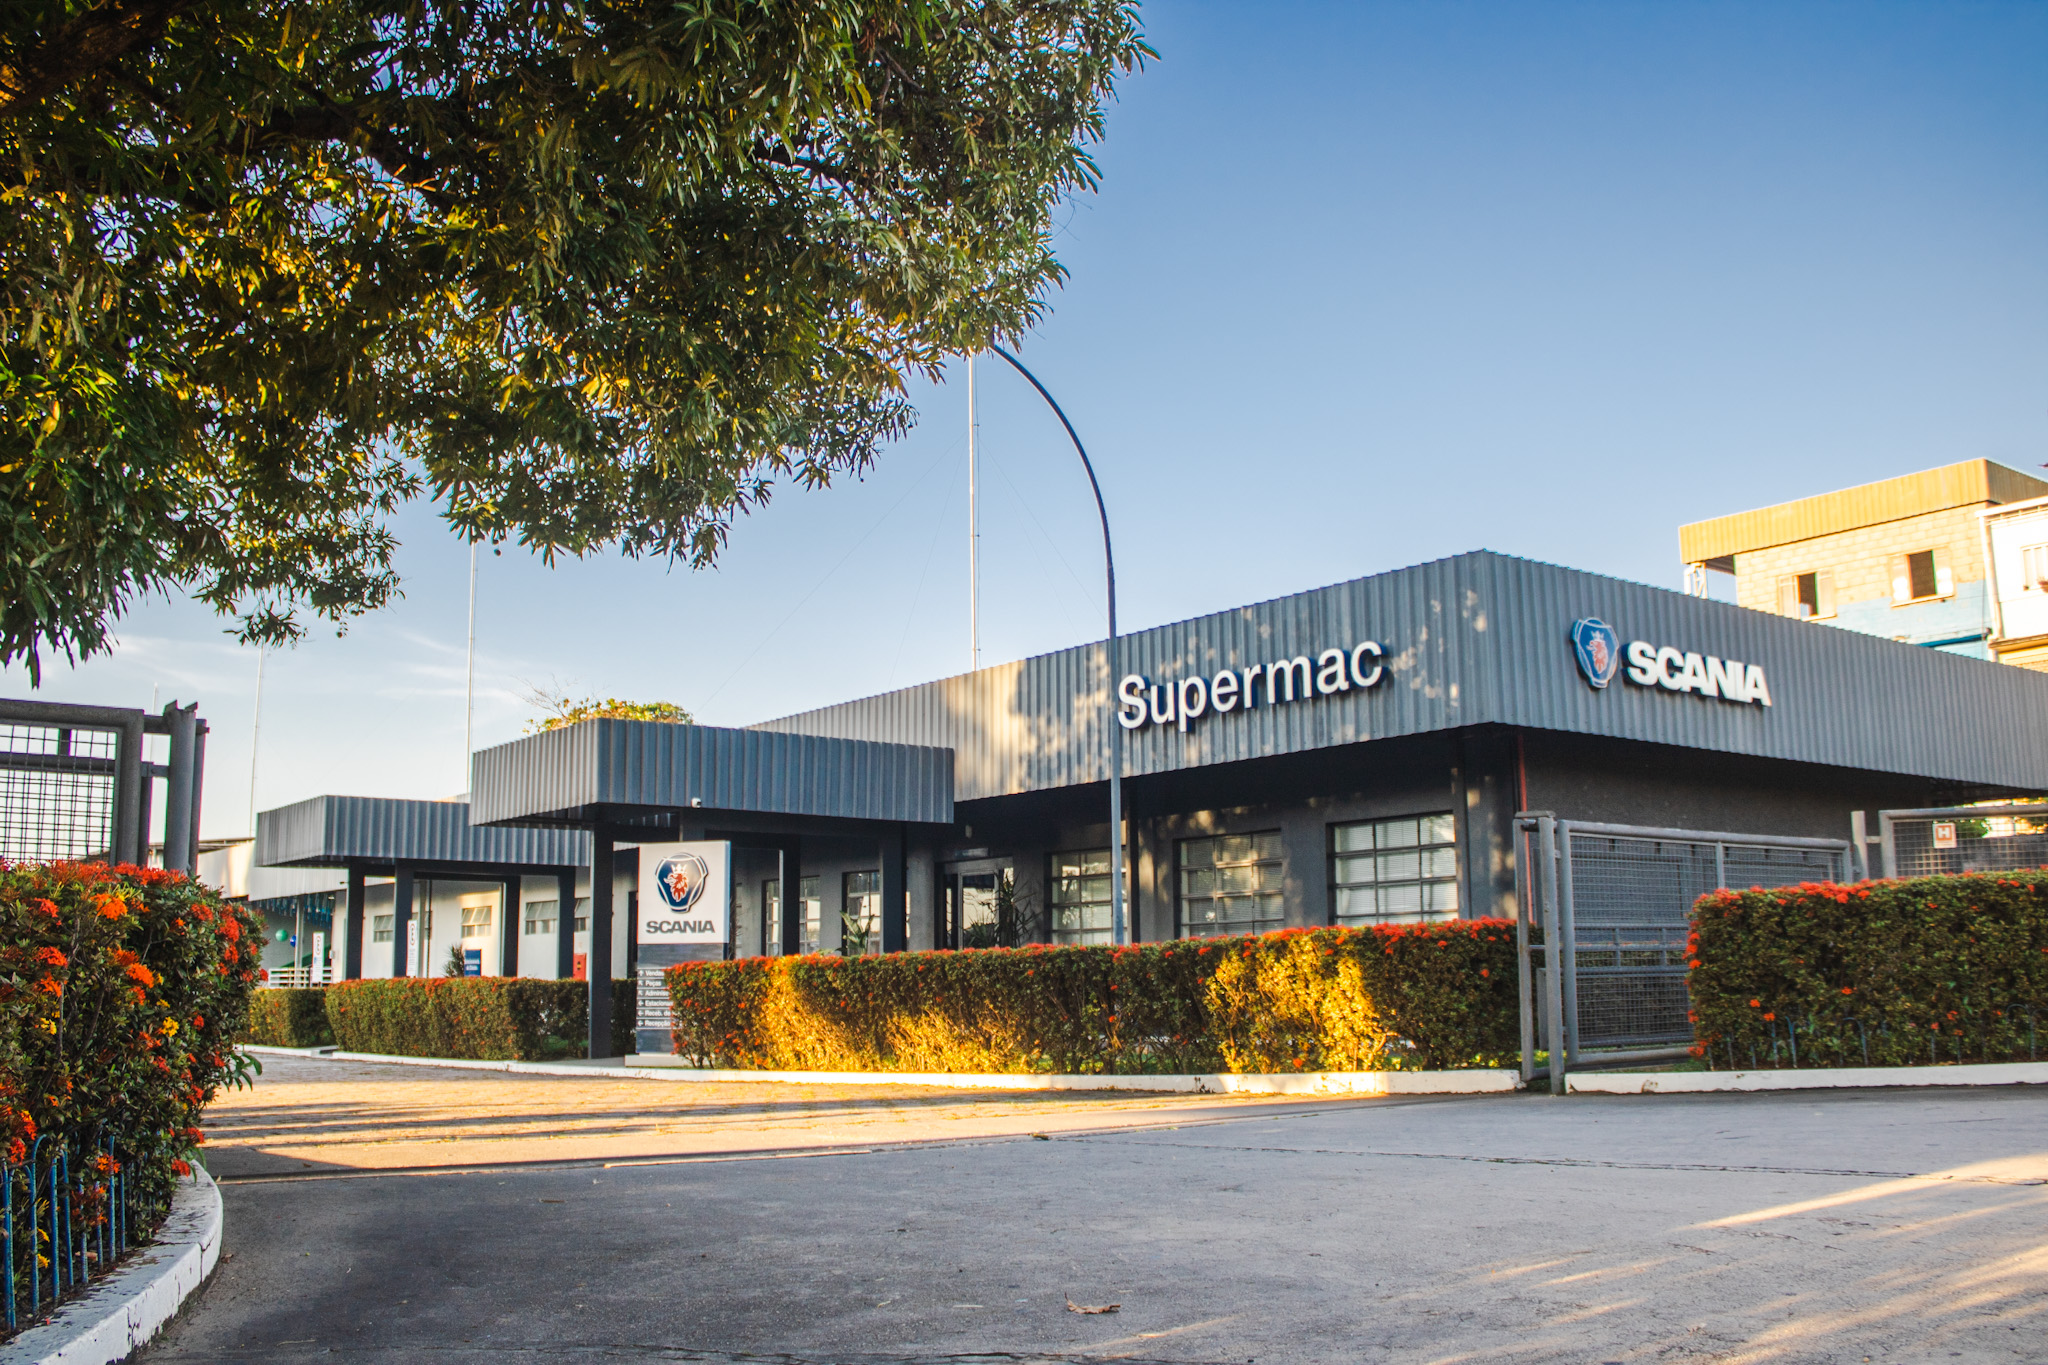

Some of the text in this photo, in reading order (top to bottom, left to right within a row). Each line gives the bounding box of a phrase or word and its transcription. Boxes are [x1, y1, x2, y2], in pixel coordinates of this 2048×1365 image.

[1626, 640, 1773, 707] SCANIA
[1117, 640, 1383, 733] Supermac
[1937, 826, 1951, 839] H
[646, 920, 716, 934] SCANIA
[645, 979, 662, 988] Peças
[645, 1019, 671, 1028] Recepção
